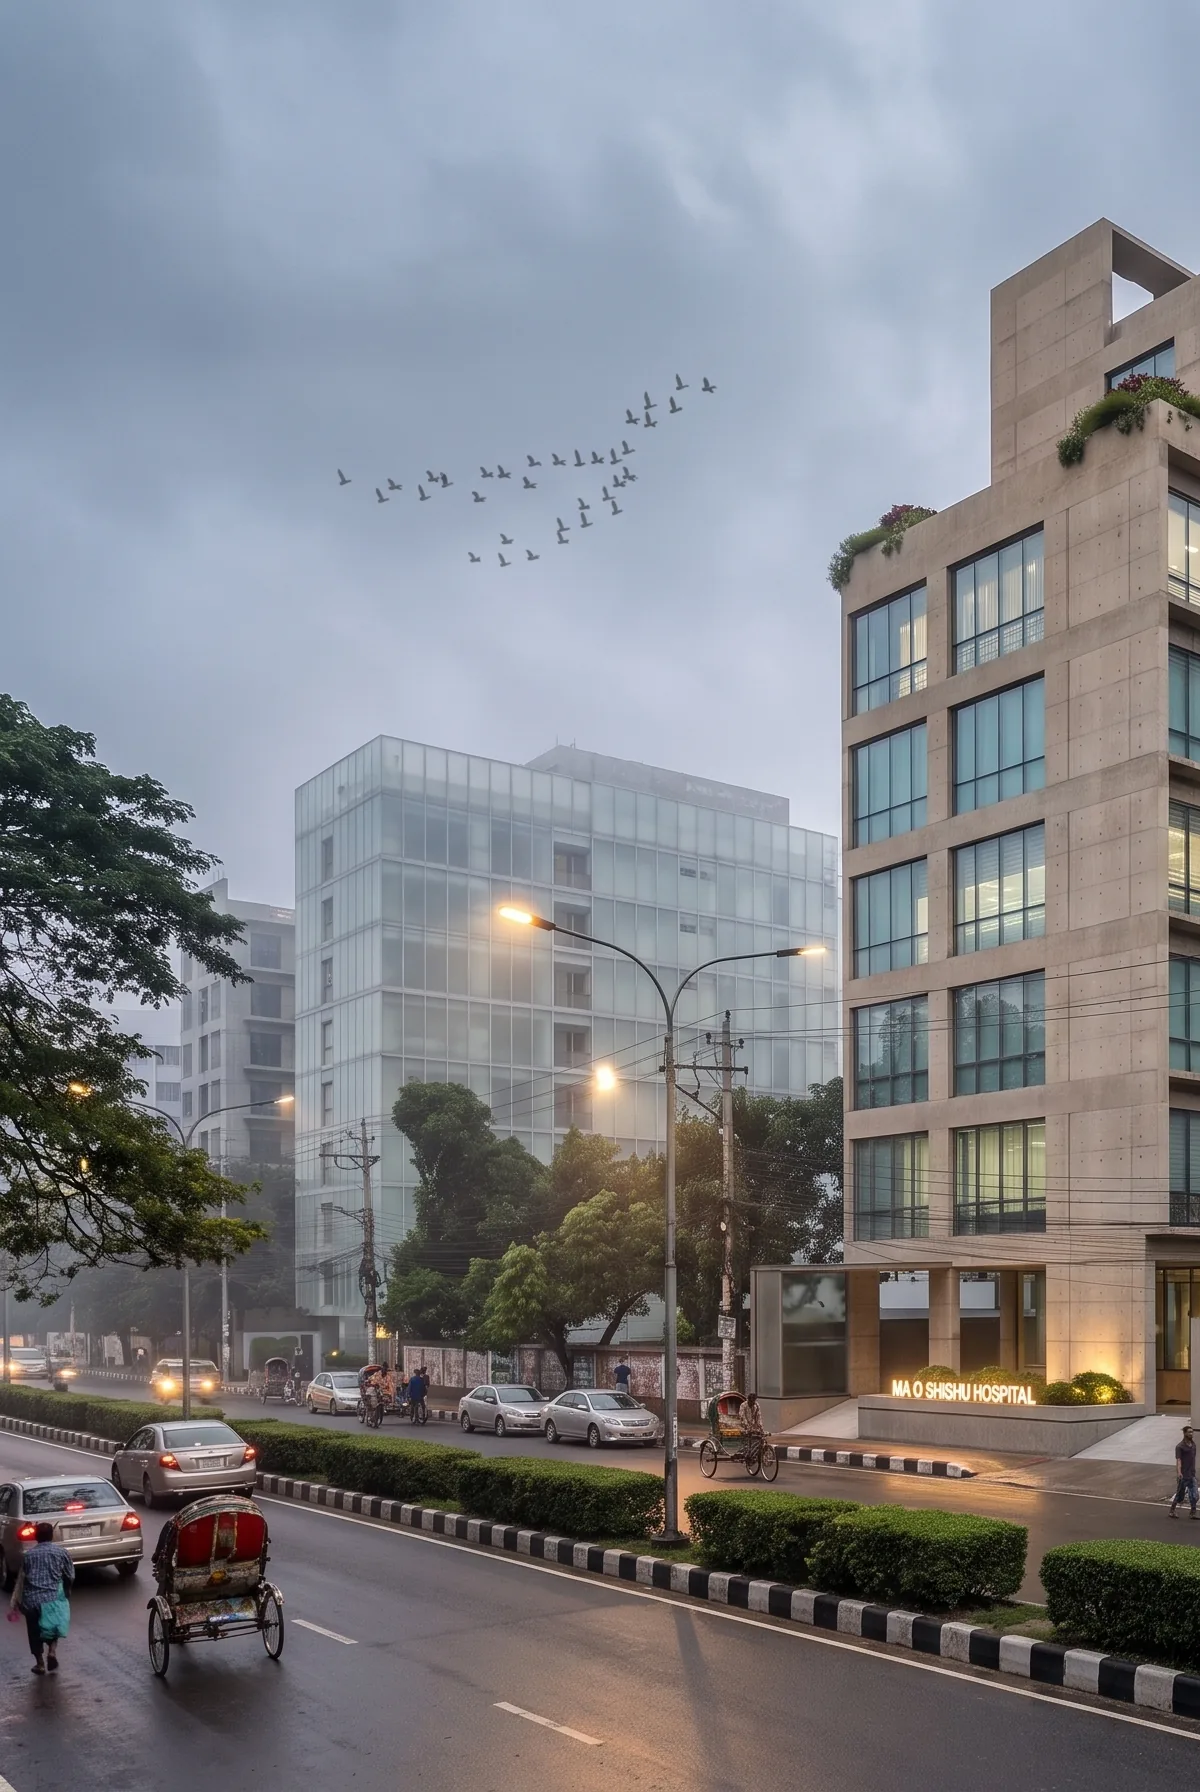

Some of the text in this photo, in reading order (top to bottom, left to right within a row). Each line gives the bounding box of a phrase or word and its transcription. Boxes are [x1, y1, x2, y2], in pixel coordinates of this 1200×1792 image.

[892, 1380, 1036, 1405] MA O SHISHU HOSPITAL
